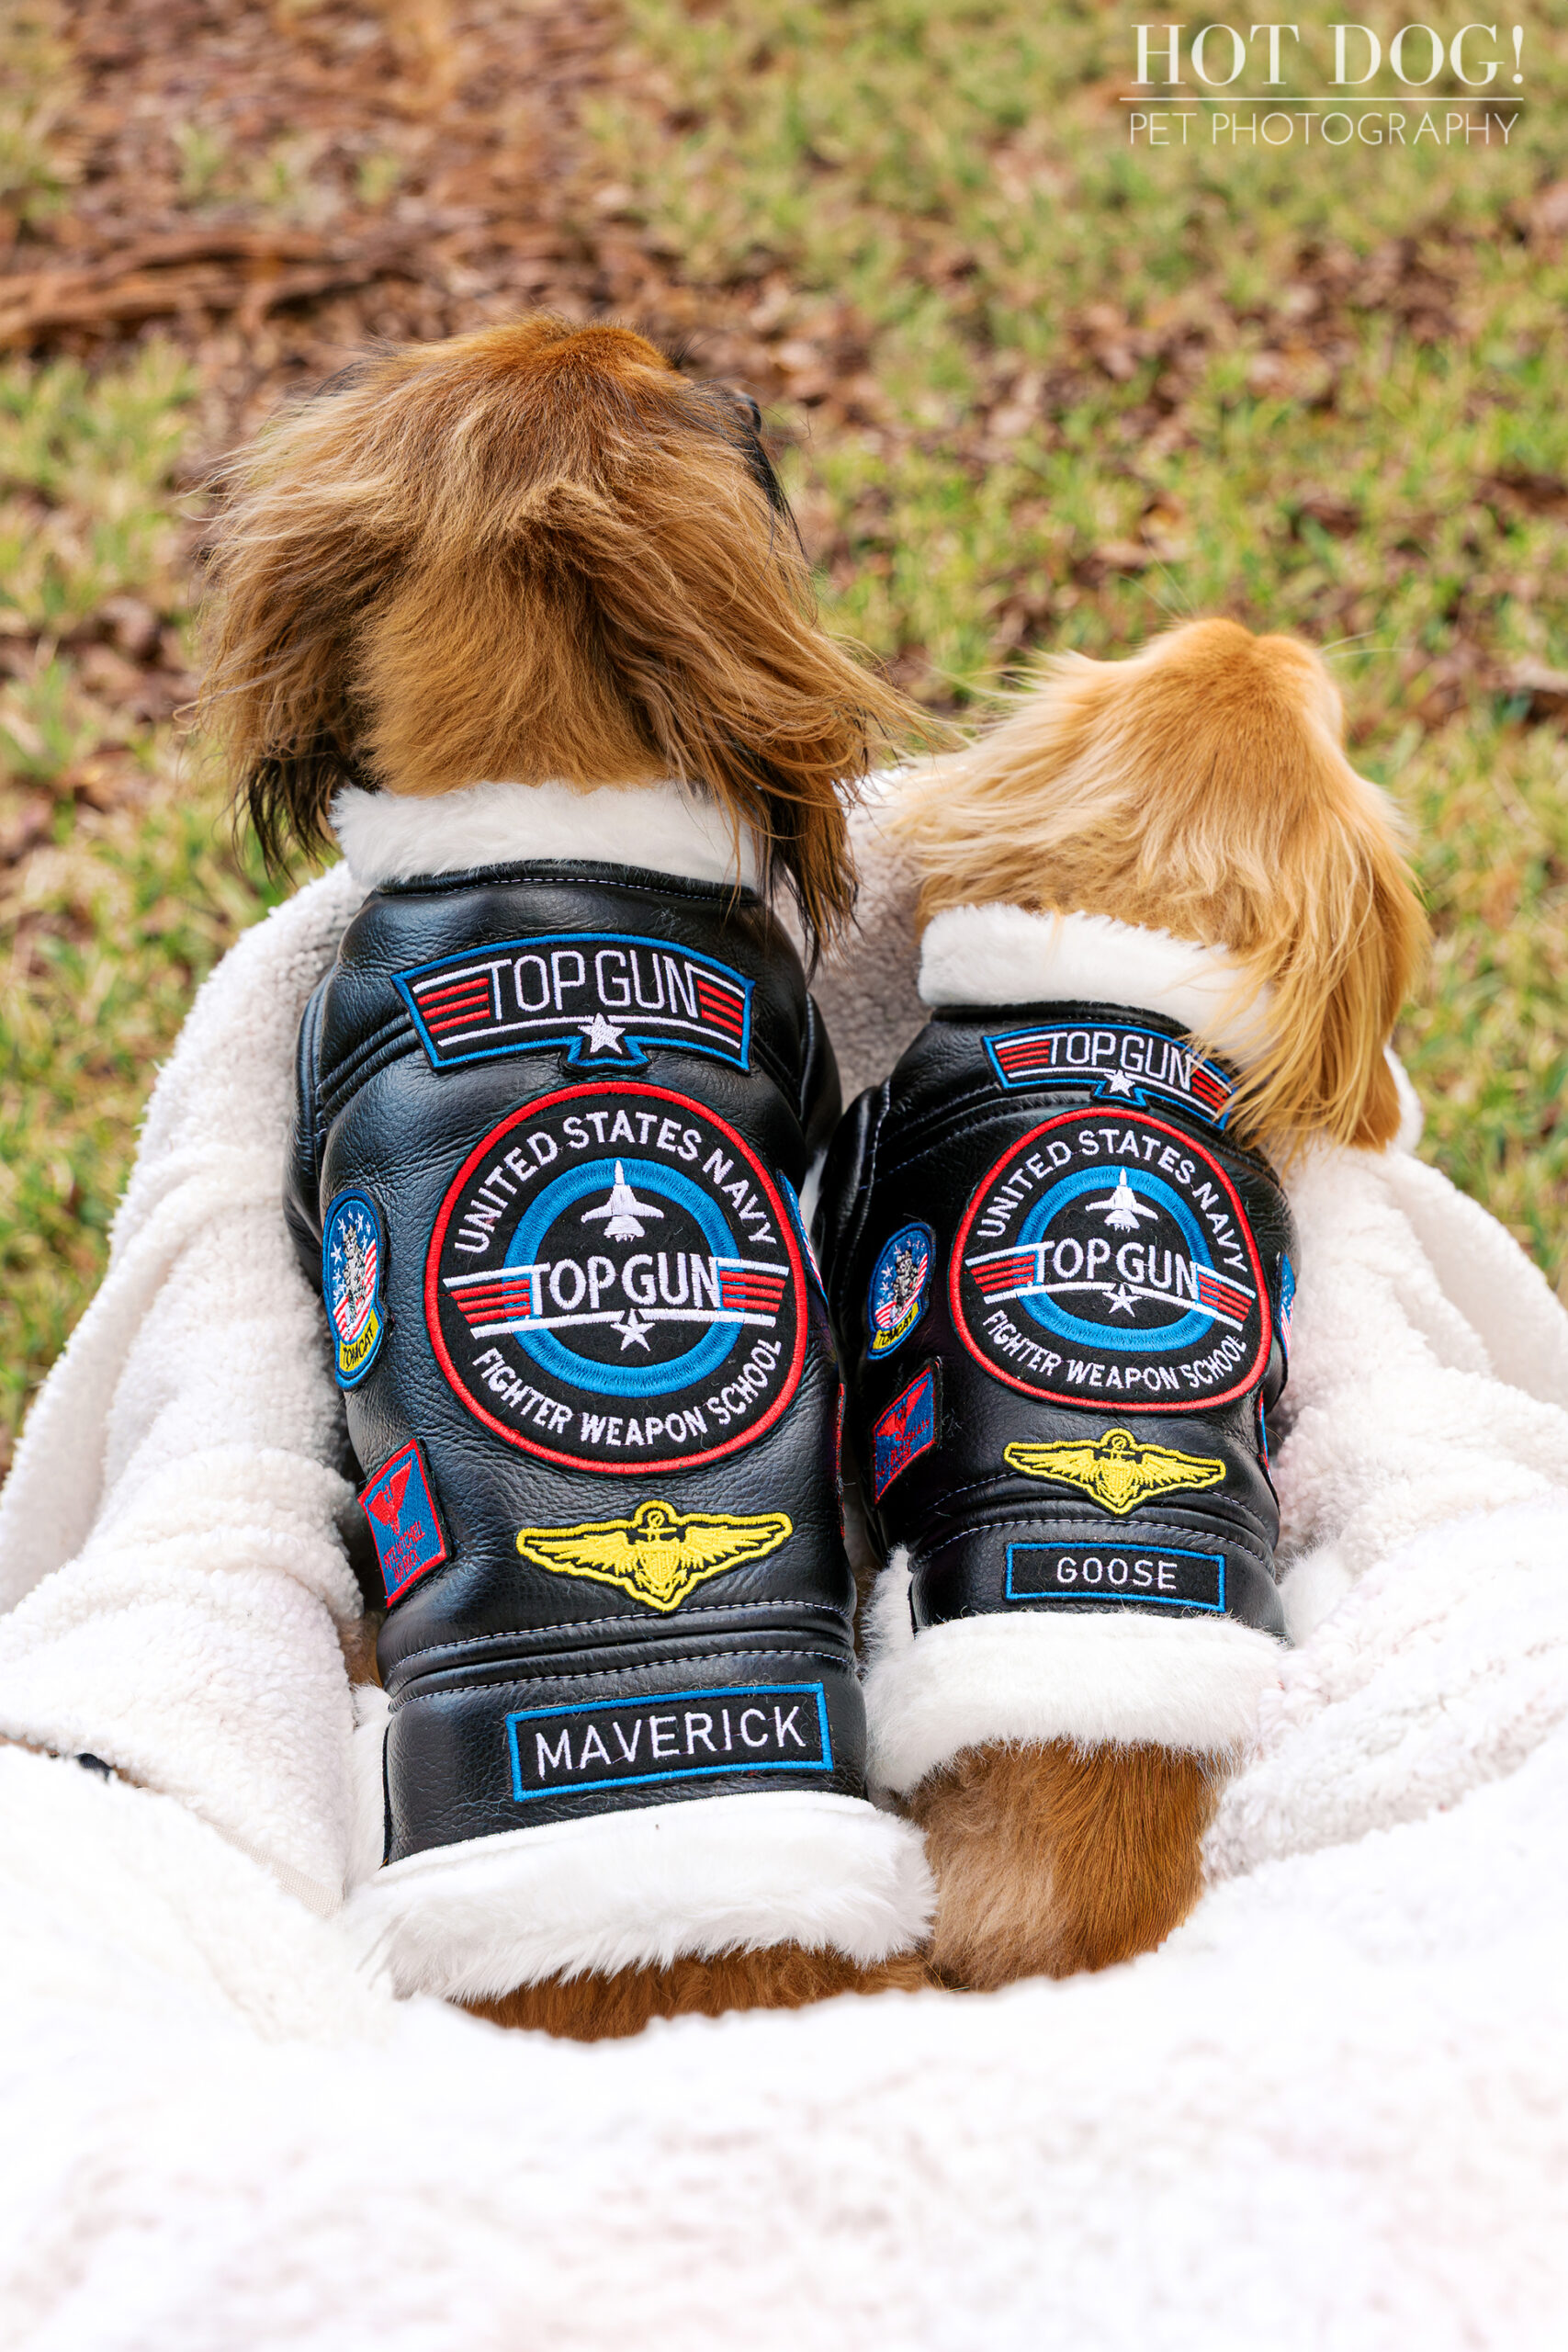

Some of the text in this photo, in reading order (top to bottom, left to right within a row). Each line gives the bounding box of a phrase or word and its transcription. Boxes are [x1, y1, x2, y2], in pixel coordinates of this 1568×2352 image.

[488, 949, 699, 1020] TOP GUN
[1050, 1031, 1194, 1091] TOP GUN
[454, 1110, 778, 1254] UNITED STATES NAVY
[976, 1128, 1248, 1272] UNITED STATES NAVY
[530, 1251, 724, 1316] TOP GUN
[1034, 1238, 1200, 1301] TOP GUN
[343, 1321, 375, 1370] TOMCAT
[982, 1309, 1248, 1392] FIGHTER WEAPON SCHOOL
[469, 1339, 783, 1447] FIGHTER WEAPON SCHOOL
[1056, 1556, 1178, 1590] GOOSE
[535, 1705, 807, 1781] MAVERICK
